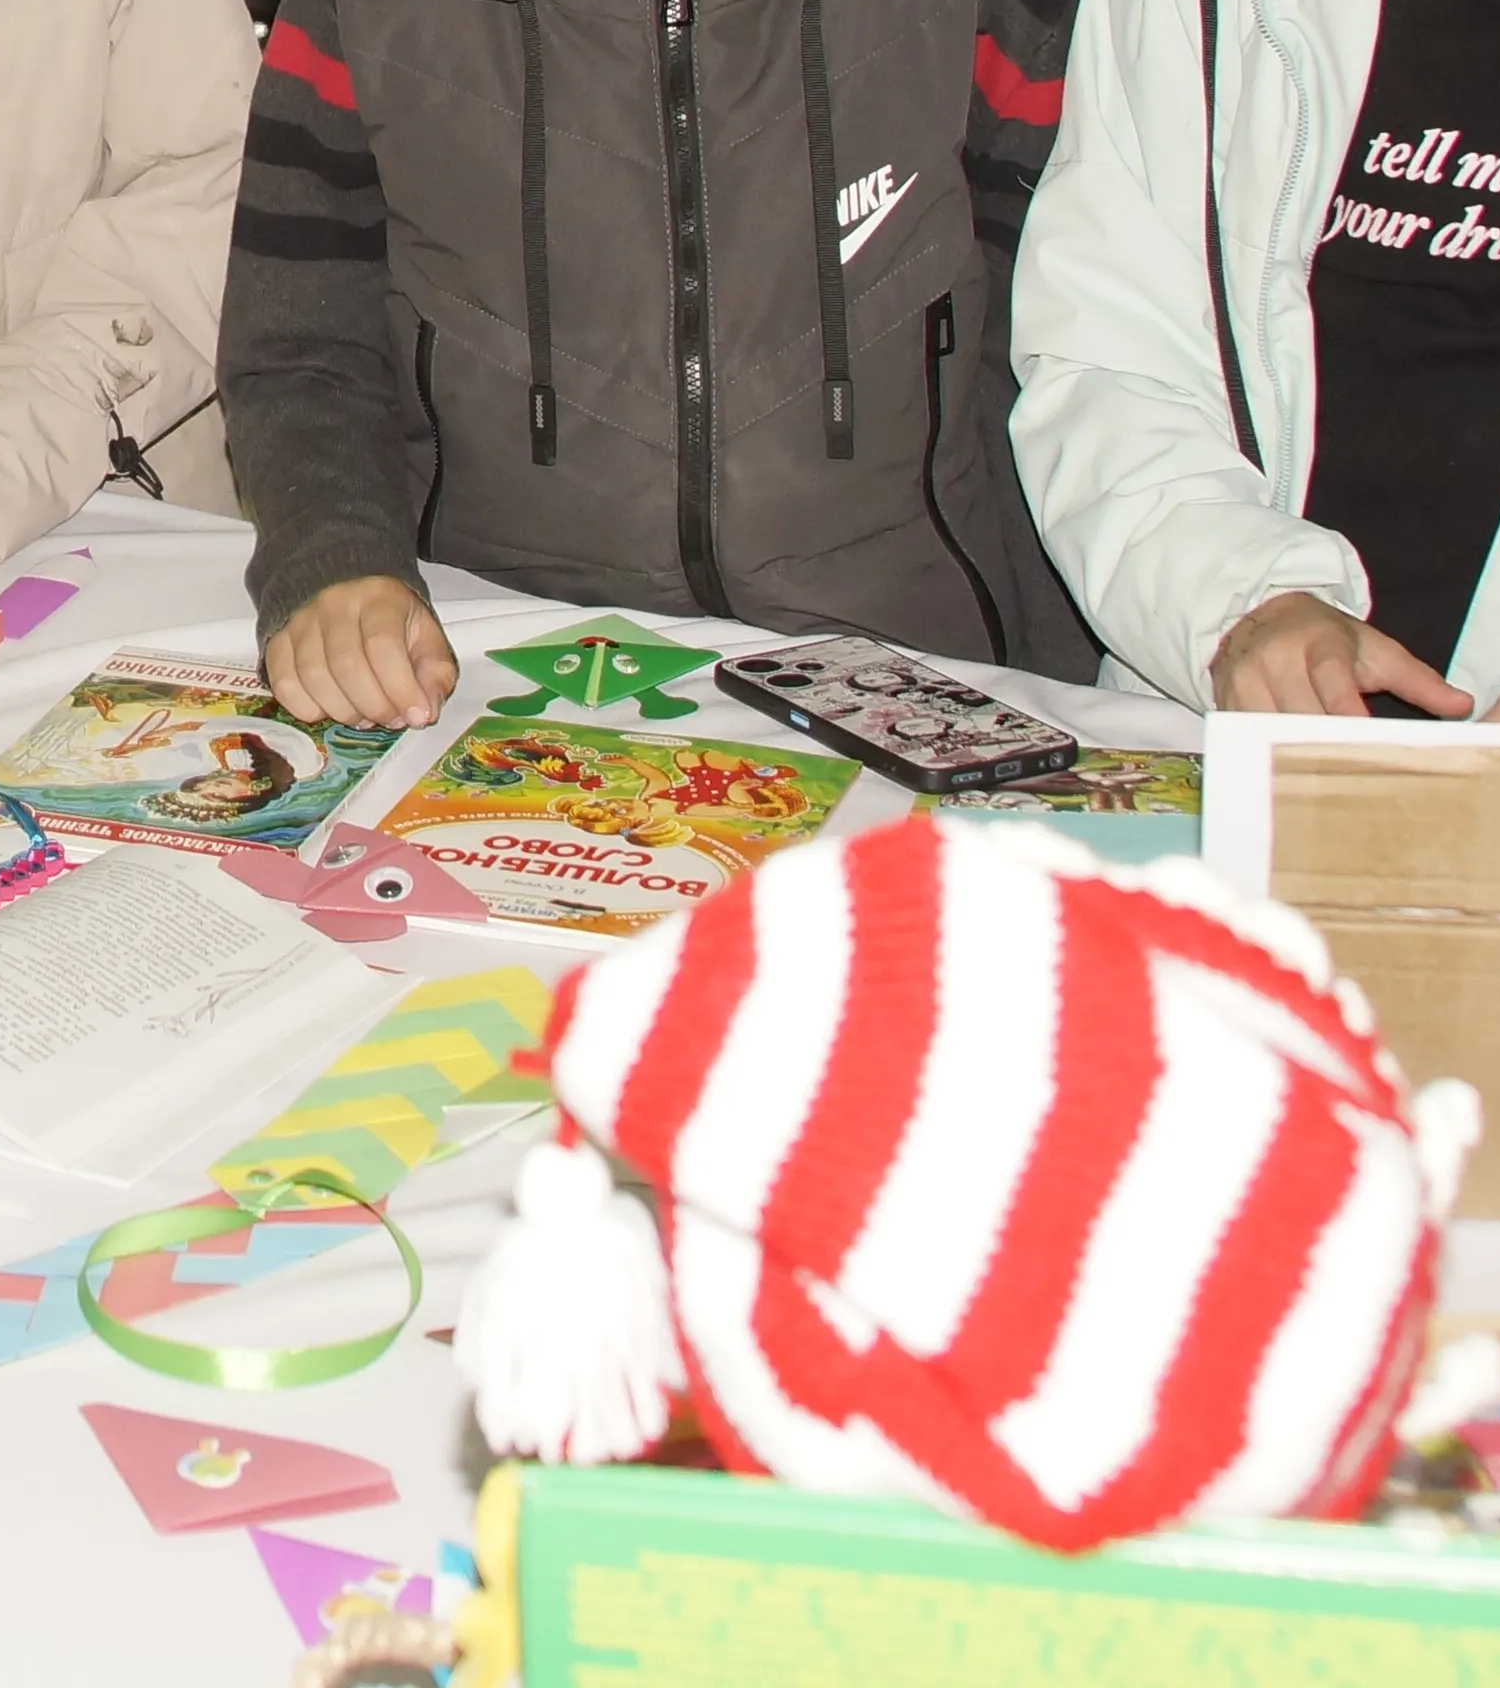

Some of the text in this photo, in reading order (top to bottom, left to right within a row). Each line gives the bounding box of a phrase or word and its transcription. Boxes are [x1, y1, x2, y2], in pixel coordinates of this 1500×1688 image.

[1363, 127, 1461, 185] tell
[1321, 194, 1433, 250] your
[105, 659, 228, 685] ШКАТУЛКА
[118, 827, 251, 855] ЕКЛАССНОЕ
[483, 835, 653, 867] СЛОВО
